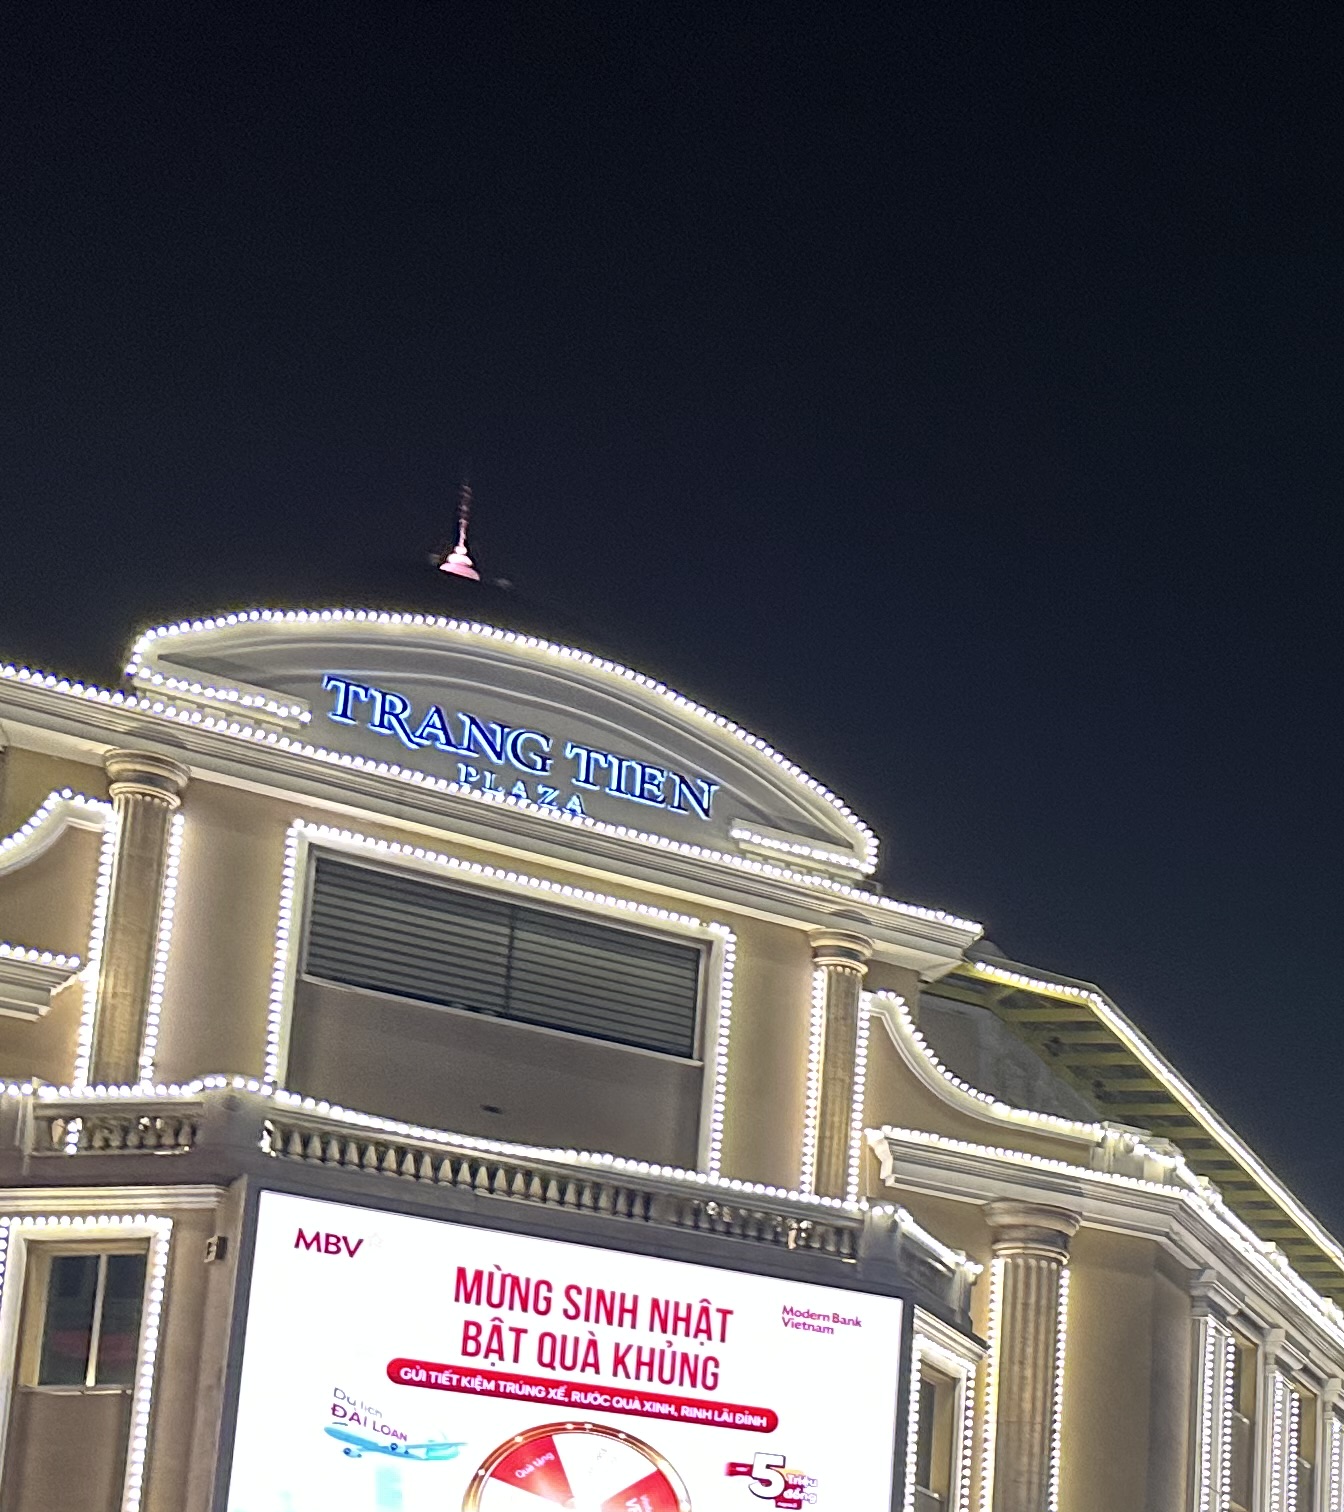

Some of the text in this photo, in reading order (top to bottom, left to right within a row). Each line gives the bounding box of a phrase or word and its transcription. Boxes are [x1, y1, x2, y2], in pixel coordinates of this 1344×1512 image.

[323, 674, 720, 820] TRANG TIEN
[457, 762, 588, 817] PLAZA
[293, 1227, 364, 1258] MBV
[454, 1264, 734, 1346] MỪNG SINH NHẬT
[781, 1316, 835, 1335] Vietnam
[782, 1304, 862, 1328] Modern Bank
[460, 1316, 720, 1391] BẬT QUÀ KHỦNG
[333, 1387, 357, 1406] Du
[461, 1375, 496, 1392] KIỆM
[680, 1405, 713, 1419] RINH
[373, 1420, 408, 1442] LOAN
[748, 1452, 786, 1500] 5
